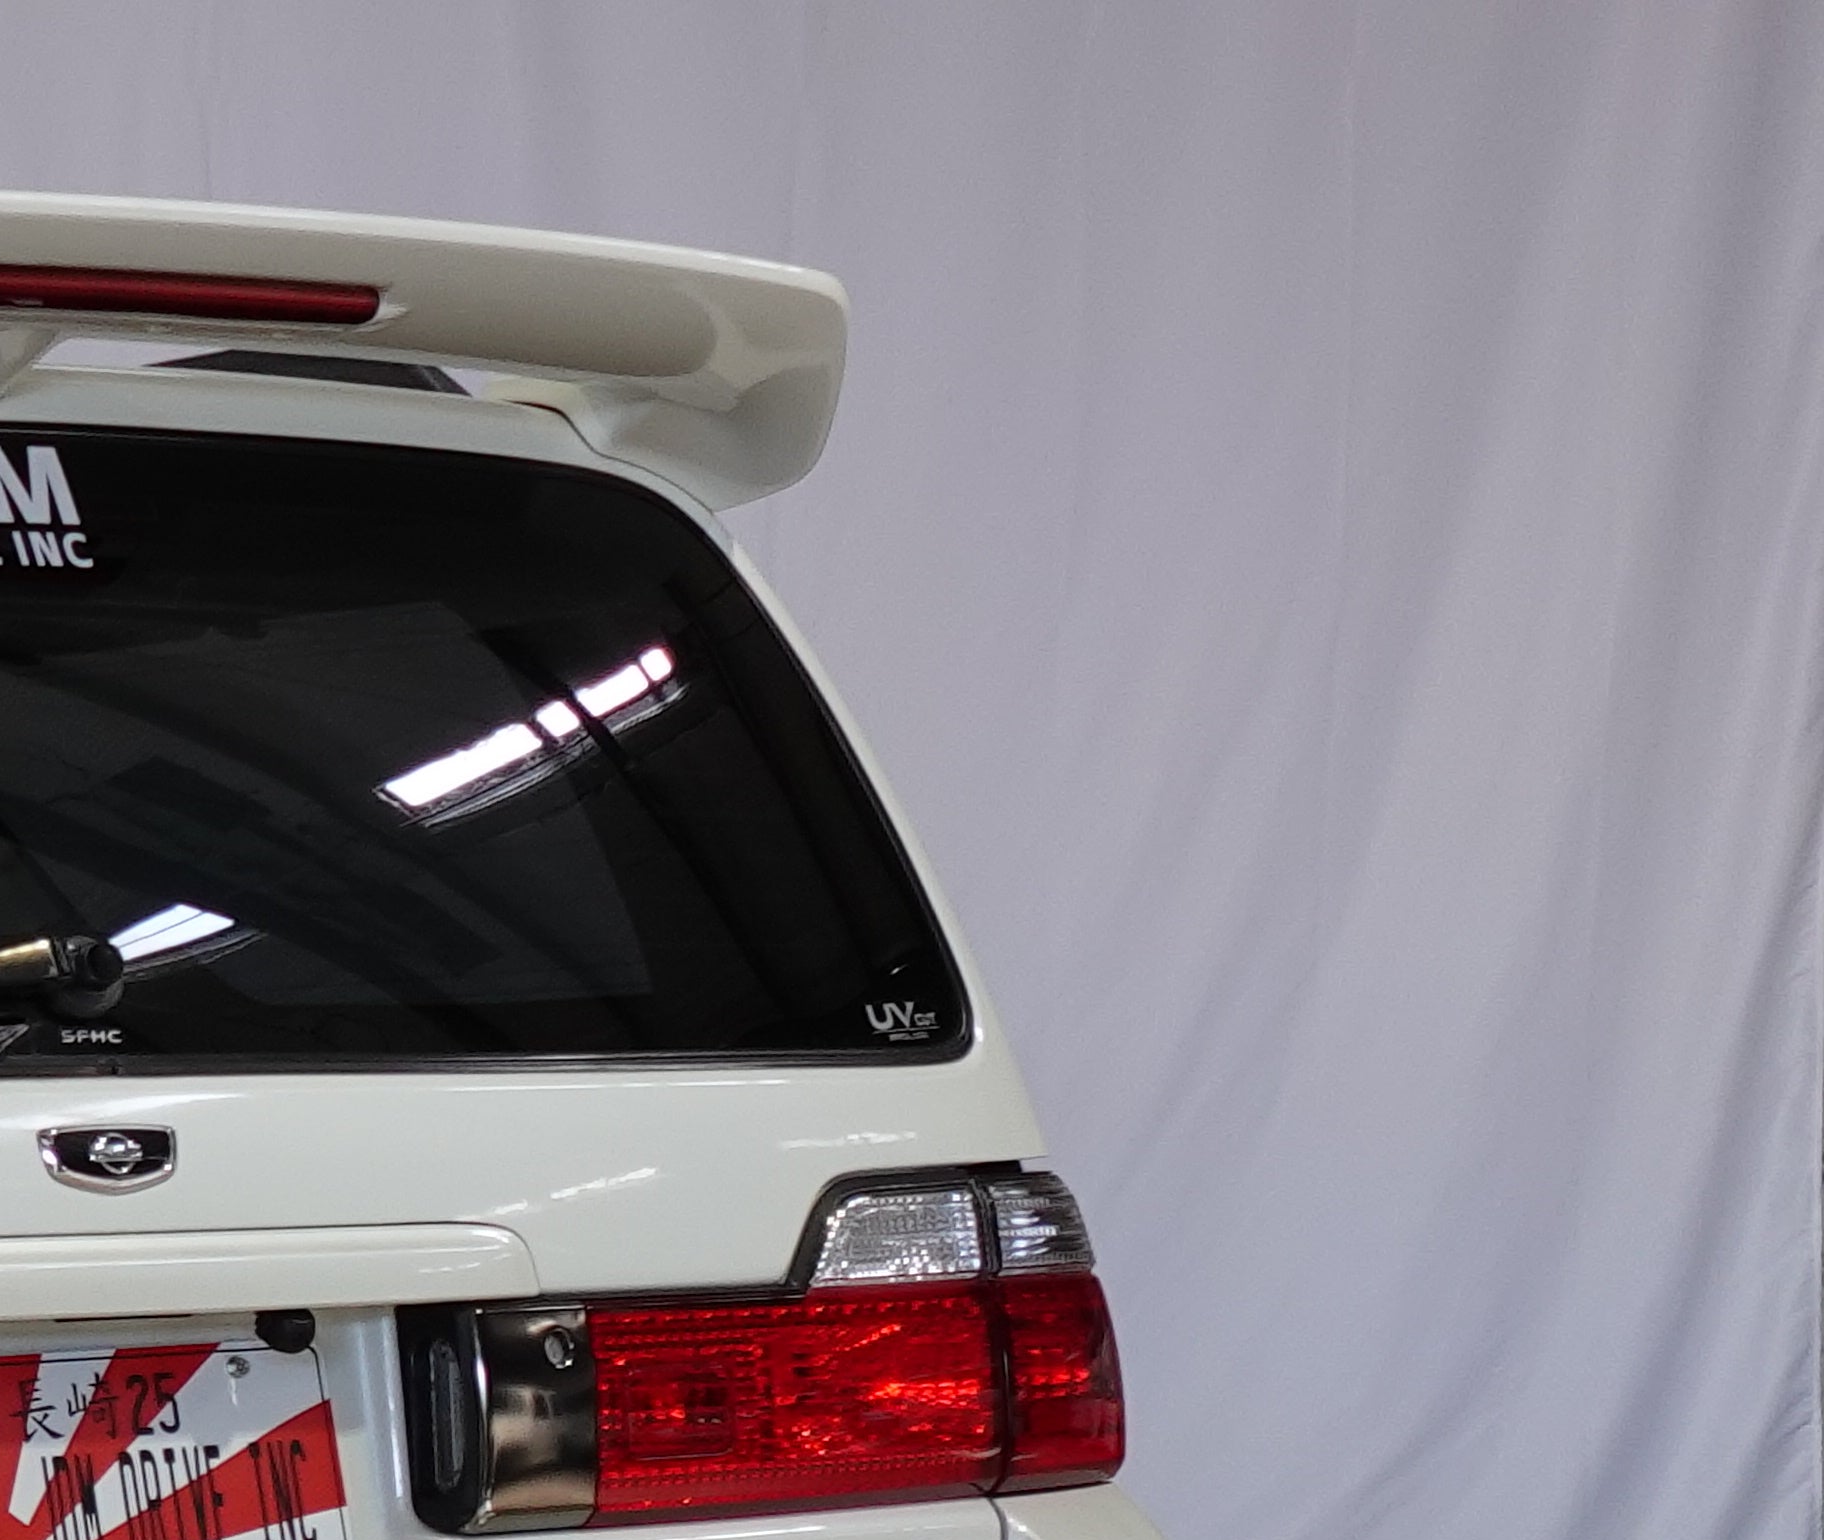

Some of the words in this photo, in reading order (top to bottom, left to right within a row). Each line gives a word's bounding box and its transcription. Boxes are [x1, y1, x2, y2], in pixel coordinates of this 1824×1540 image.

[12, 531, 95, 569] INC
[865, 1001, 915, 1030] UV
[126, 1372, 181, 1436] 25
